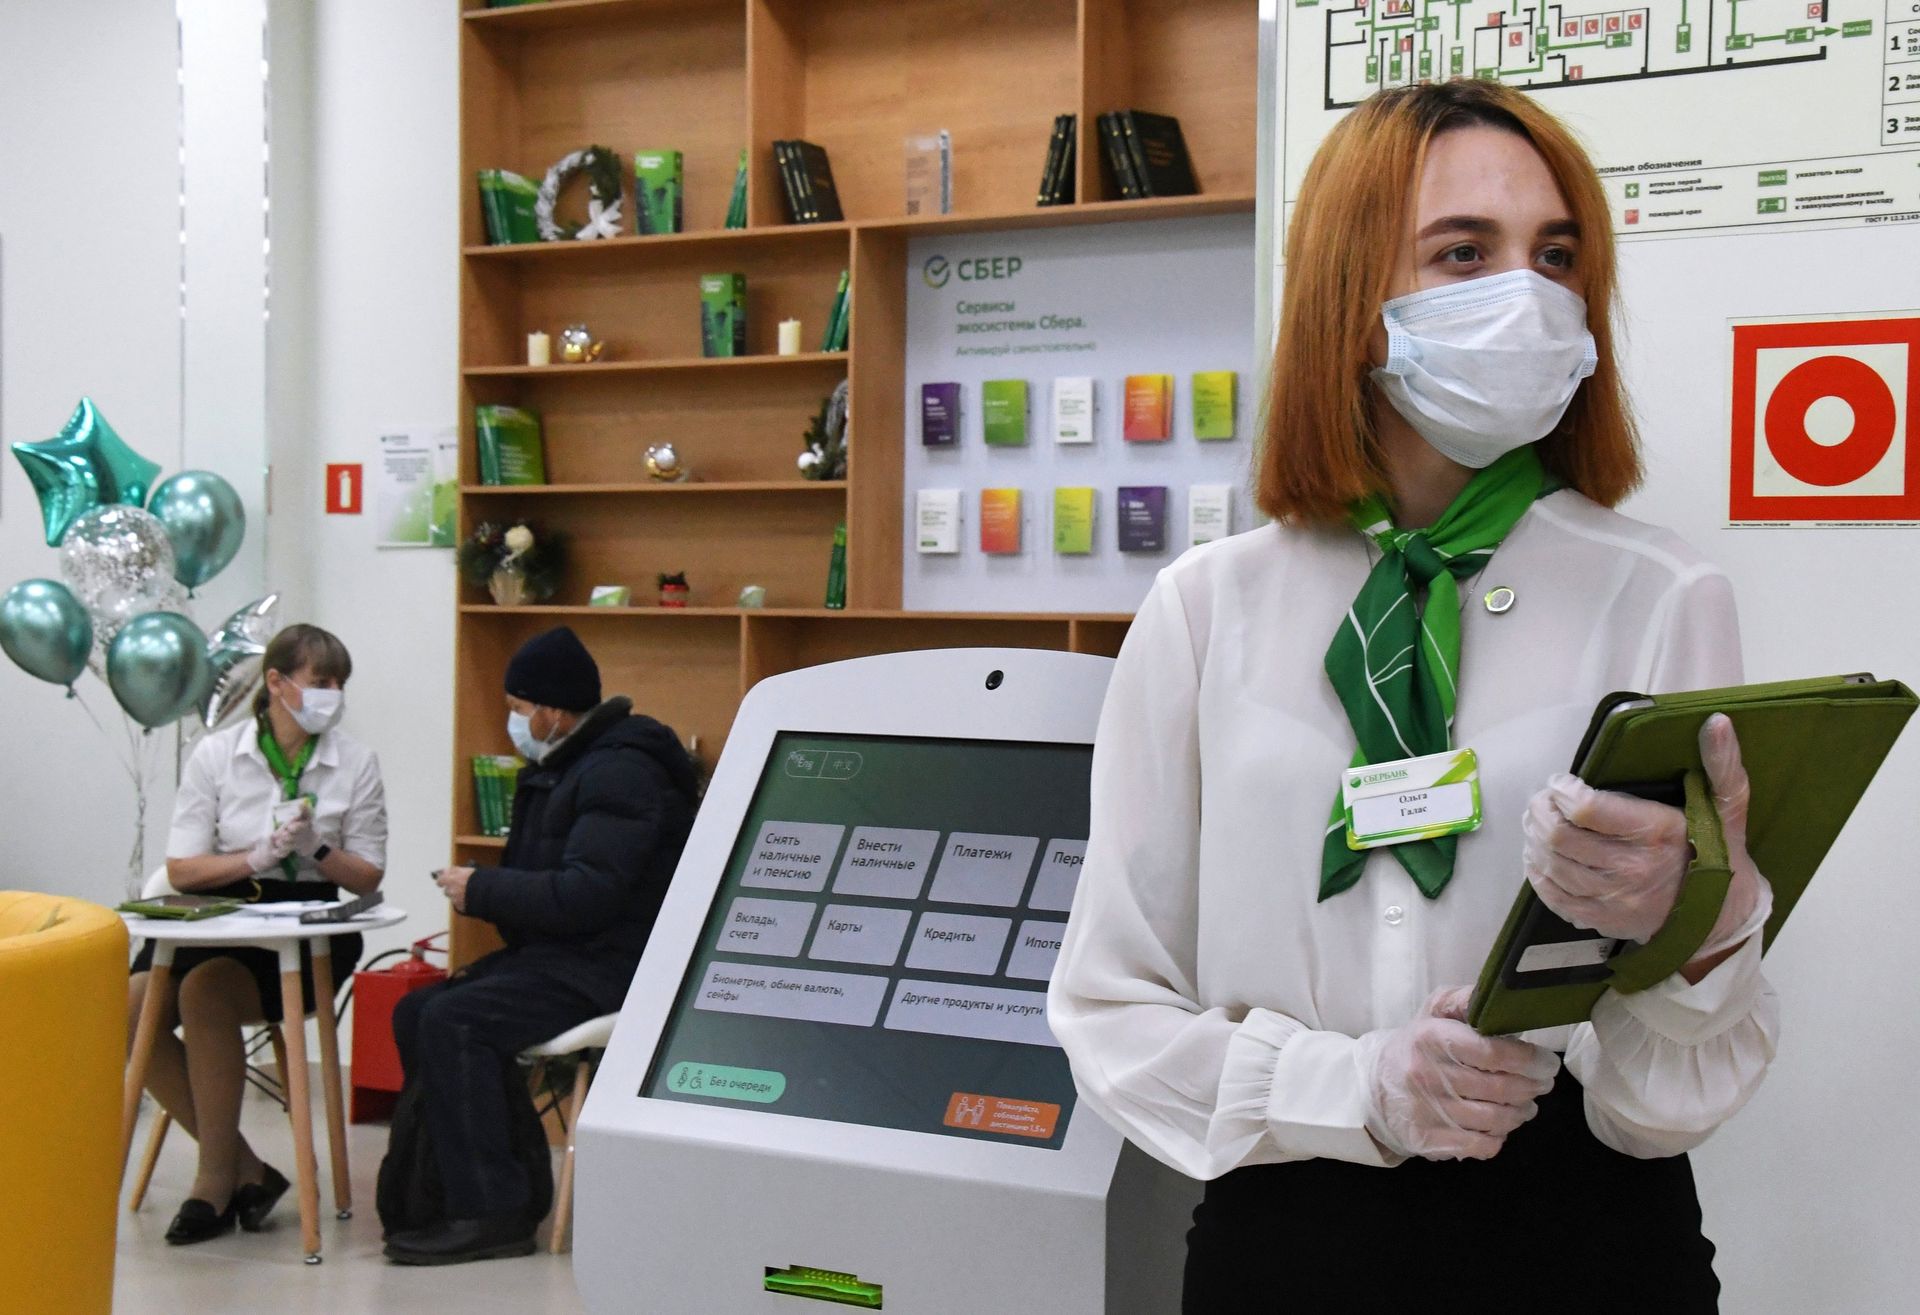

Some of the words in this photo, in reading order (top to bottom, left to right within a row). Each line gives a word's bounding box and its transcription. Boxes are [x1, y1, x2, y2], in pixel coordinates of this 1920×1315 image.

[1890, 36, 1901, 50] 1
[1888, 76, 1900, 92] 2
[1886, 118, 1898, 134] 3
[1638, 160, 1702, 170] обозначения
[1796, 170, 1832, 179] указатель
[958, 256, 1022, 281] СБЕР
[956, 300, 1016, 316] Сервисы
[956, 319, 1036, 334] экосистемы
[1363, 769, 1408, 784] СБЕРБАНК
[1399, 792, 1428, 804] Ольга
[1400, 806, 1427, 817] Галас
[765, 832, 800, 846] Снять
[857, 838, 902, 853] Внести
[758, 850, 821, 864] наличные
[952, 844, 1012, 860] Платежи
[851, 856, 916, 870] наличные
[753, 867, 761, 876] и
[764, 867, 812, 880] пенсию
[734, 912, 778, 927] Вклады,
[827, 919, 863, 933] Карты
[729, 930, 759, 940] счета
[924, 927, 976, 942] Кредиты
[712, 974, 767, 989] Биометрия,
[770, 979, 801, 991] обмен
[804, 984, 844, 997] валюты,
[706, 988, 739, 1001] сейфы
[901, 992, 941, 1004] Другие
[942, 997, 994, 1011] продукты
[996, 1003, 1004, 1011] и
[1005, 1004, 1043, 1017] услуги
[710, 1076, 727, 1087] Без
[729, 1080, 772, 1093] очереди
